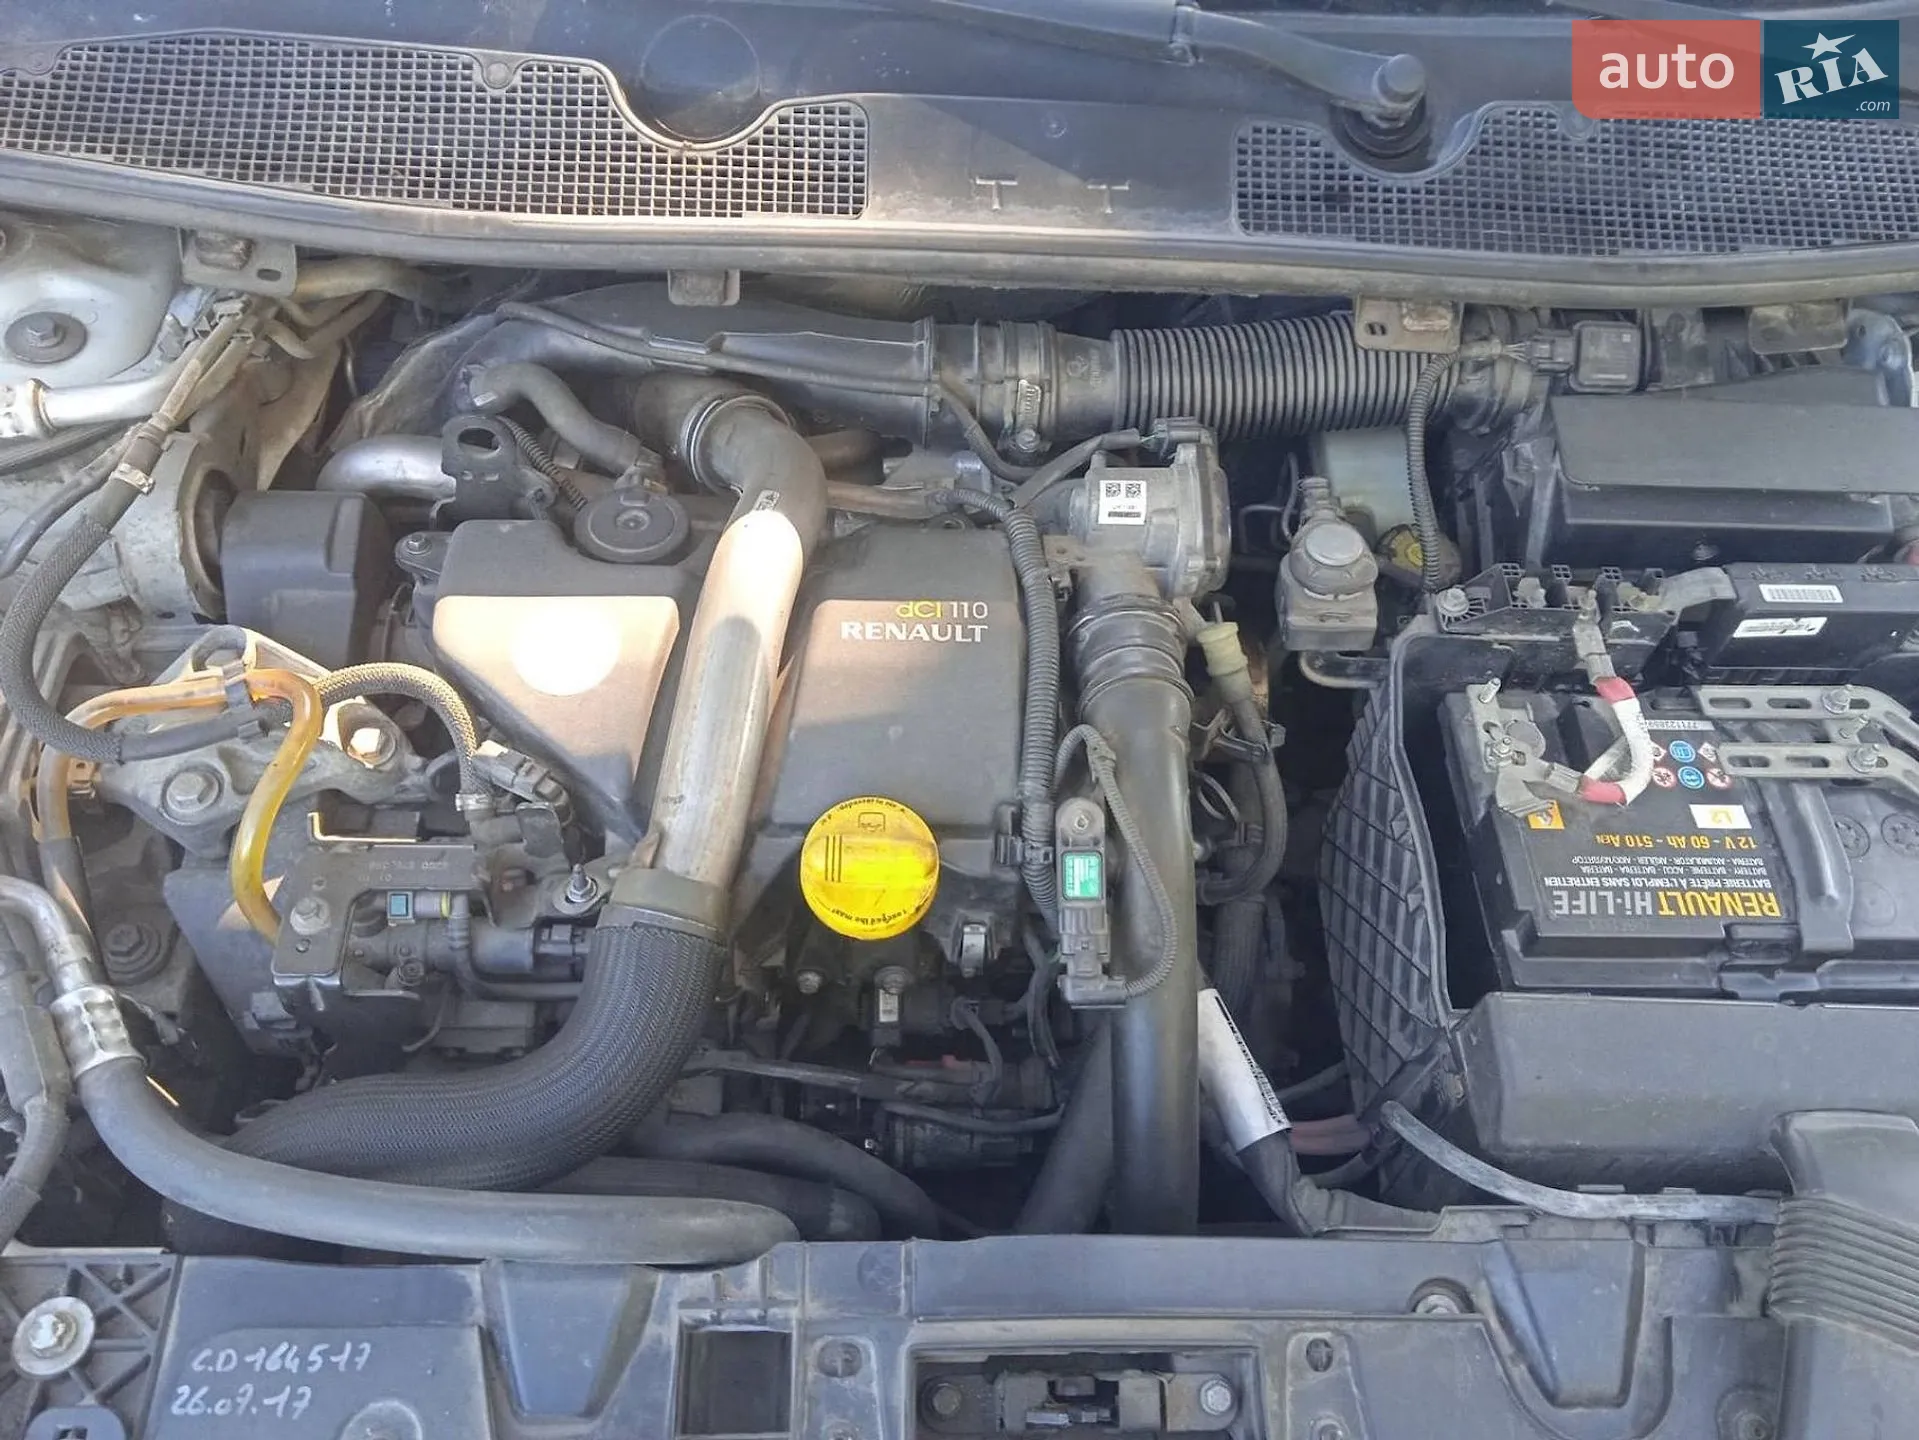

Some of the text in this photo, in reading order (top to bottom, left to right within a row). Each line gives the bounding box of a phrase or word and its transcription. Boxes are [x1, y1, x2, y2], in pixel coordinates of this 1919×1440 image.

[950, 601, 988, 619] 110
[841, 621, 988, 643] RENAULT
[1625, 834, 1654, 848] 510
[1666, 835, 1686, 849] Ah
[1691, 835, 1711, 849] 60
[1725, 836, 1736, 849] V
[1736, 836, 1757, 849] 12
[1544, 876, 1601, 887] ENTRETIEN
[1602, 877, 1630, 887] SANS
[1631, 877, 1677, 889] L'EMPLOI
[1722, 878, 1772, 889] BATTERIE
[1659, 891, 1782, 917] RENAULT
